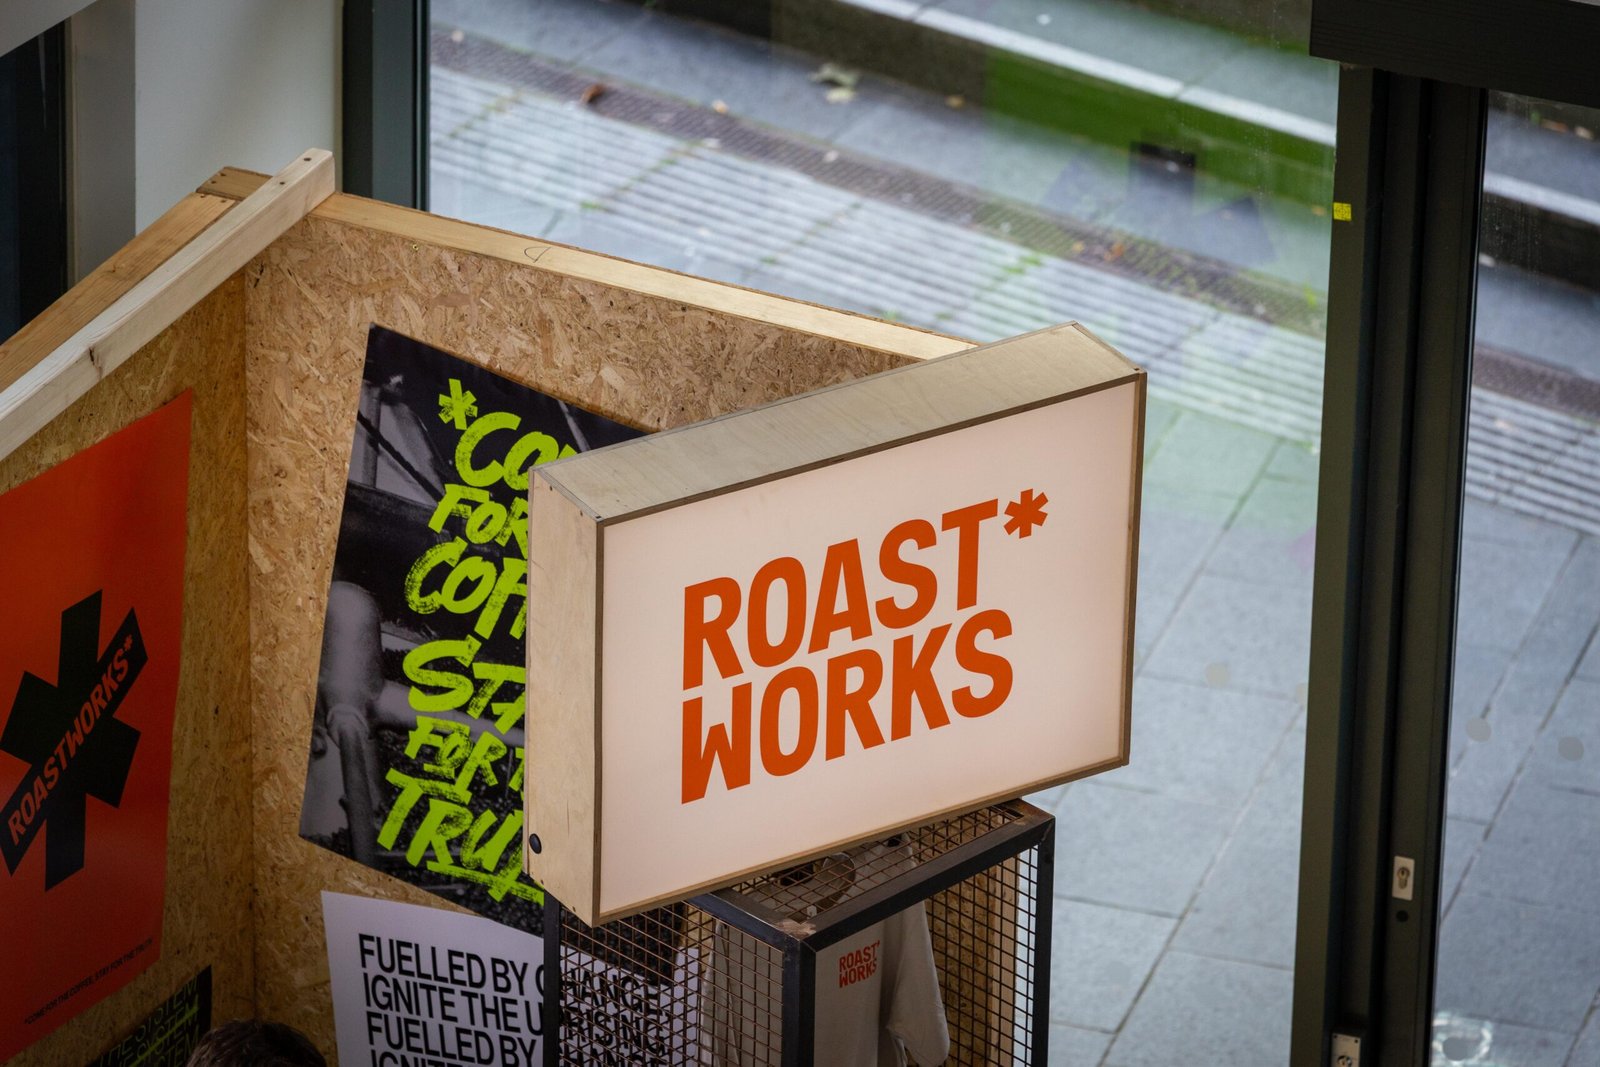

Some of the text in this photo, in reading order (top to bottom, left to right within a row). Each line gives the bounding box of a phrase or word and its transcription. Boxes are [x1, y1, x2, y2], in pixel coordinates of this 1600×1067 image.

[681, 609, 1013, 804] WORKS
[404, 715, 508, 795] FOR
[358, 933, 487, 988] FUELLED
[491, 956, 528, 996] BY
[839, 959, 877, 988] WORKS
[363, 972, 458, 1023] IGNITE
[461, 991, 521, 1034] THE
[366, 1010, 495, 1066] FUELLED
[499, 1034, 537, 1067] BY
